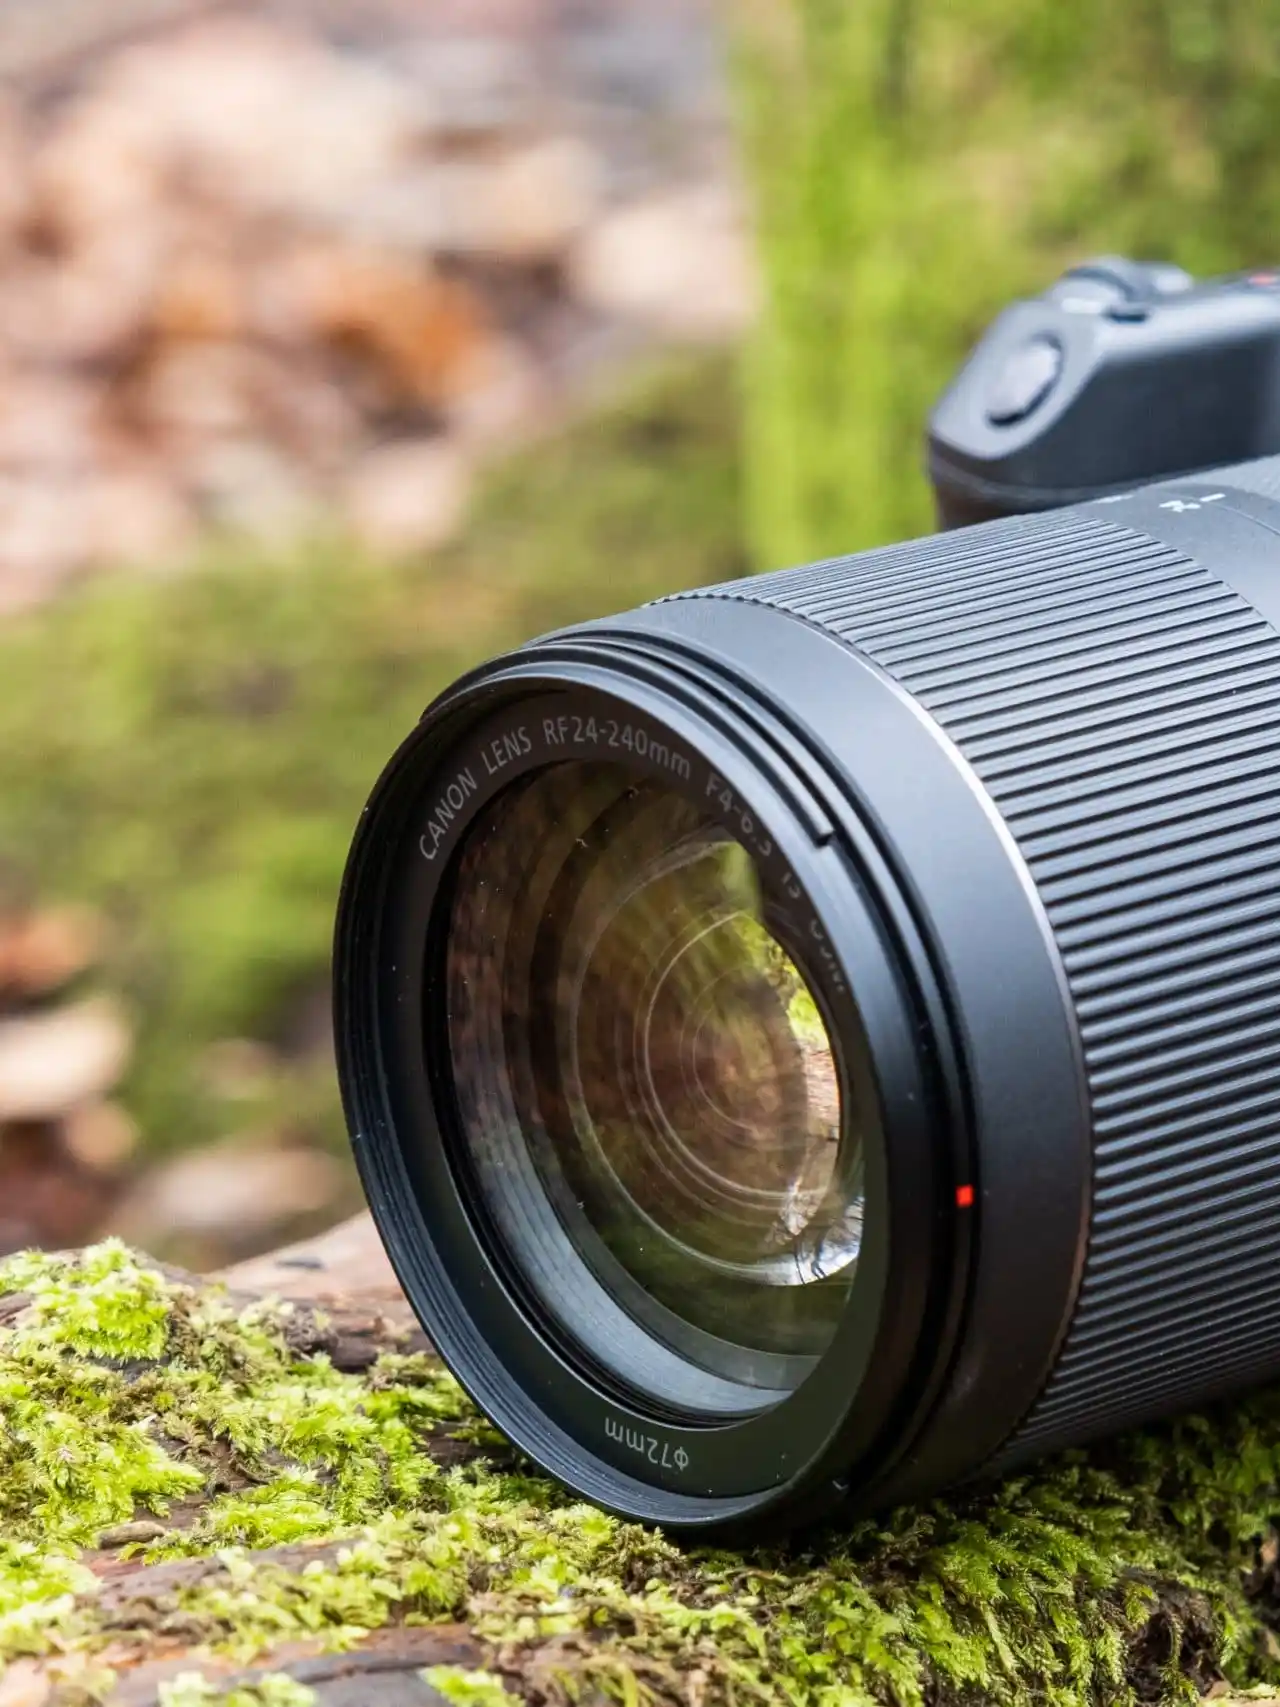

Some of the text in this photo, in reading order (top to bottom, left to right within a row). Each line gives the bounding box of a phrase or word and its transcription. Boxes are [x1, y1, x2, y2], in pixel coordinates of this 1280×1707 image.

[419, 767, 478, 860] CANON
[481, 726, 532, 775] LENS
[543, 716, 691, 780] RF24-240mm
